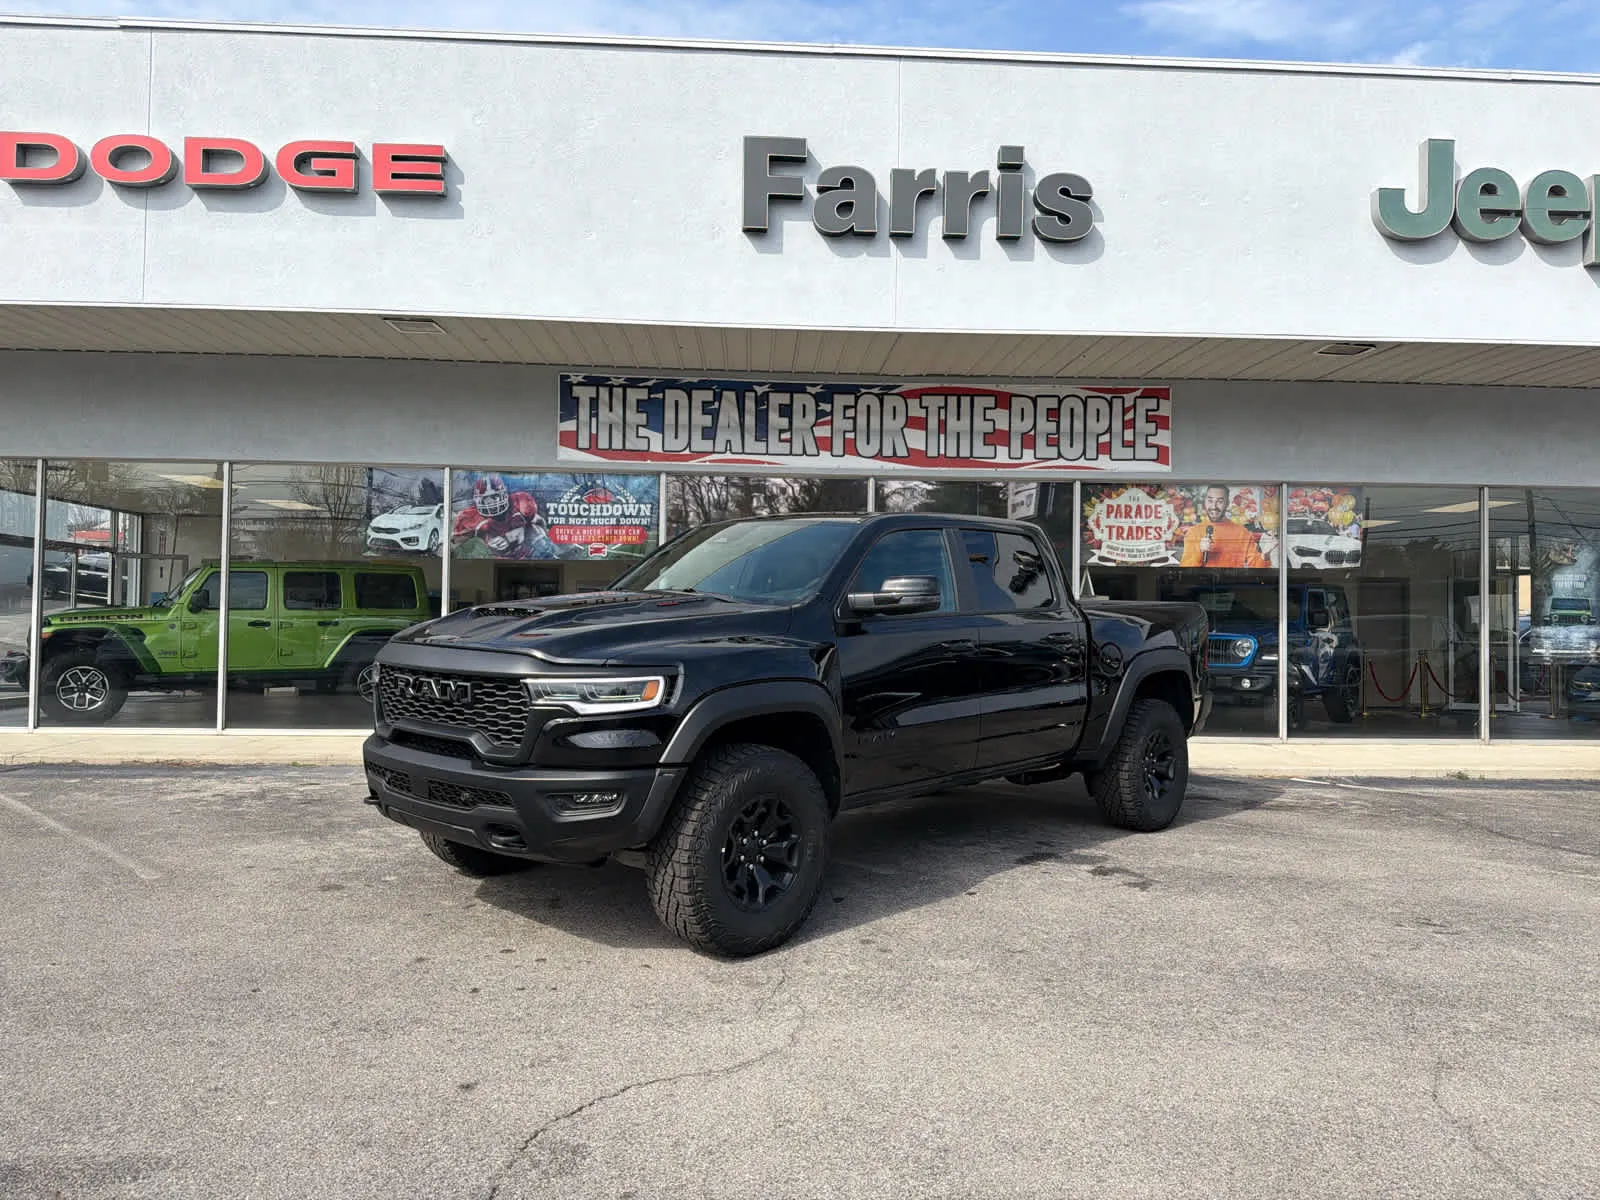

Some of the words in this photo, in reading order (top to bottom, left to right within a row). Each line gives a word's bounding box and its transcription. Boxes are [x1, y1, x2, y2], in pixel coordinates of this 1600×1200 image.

[0, 131, 449, 197] DODGE
[742, 136, 1095, 243] Farris
[1370, 138, 1600, 267] Jee
[571, 384, 651, 452] THE
[661, 388, 820, 457] DEALER
[830, 391, 909, 459] FOR
[920, 394, 997, 459] THE
[1008, 394, 1160, 461] PEOPLE
[546, 503, 652, 516] TOUCHDOWN
[1105, 503, 1163, 519] PARADE
[547, 517, 566, 525] FOR
[568, 517, 588, 525] NOT
[589, 518, 617, 526] MUCH
[619, 518, 651, 526] DOWN!
[1104, 525, 1163, 541] TRADES
[59, 613, 144, 622] RUBICON
[393, 673, 473, 704] RAM
